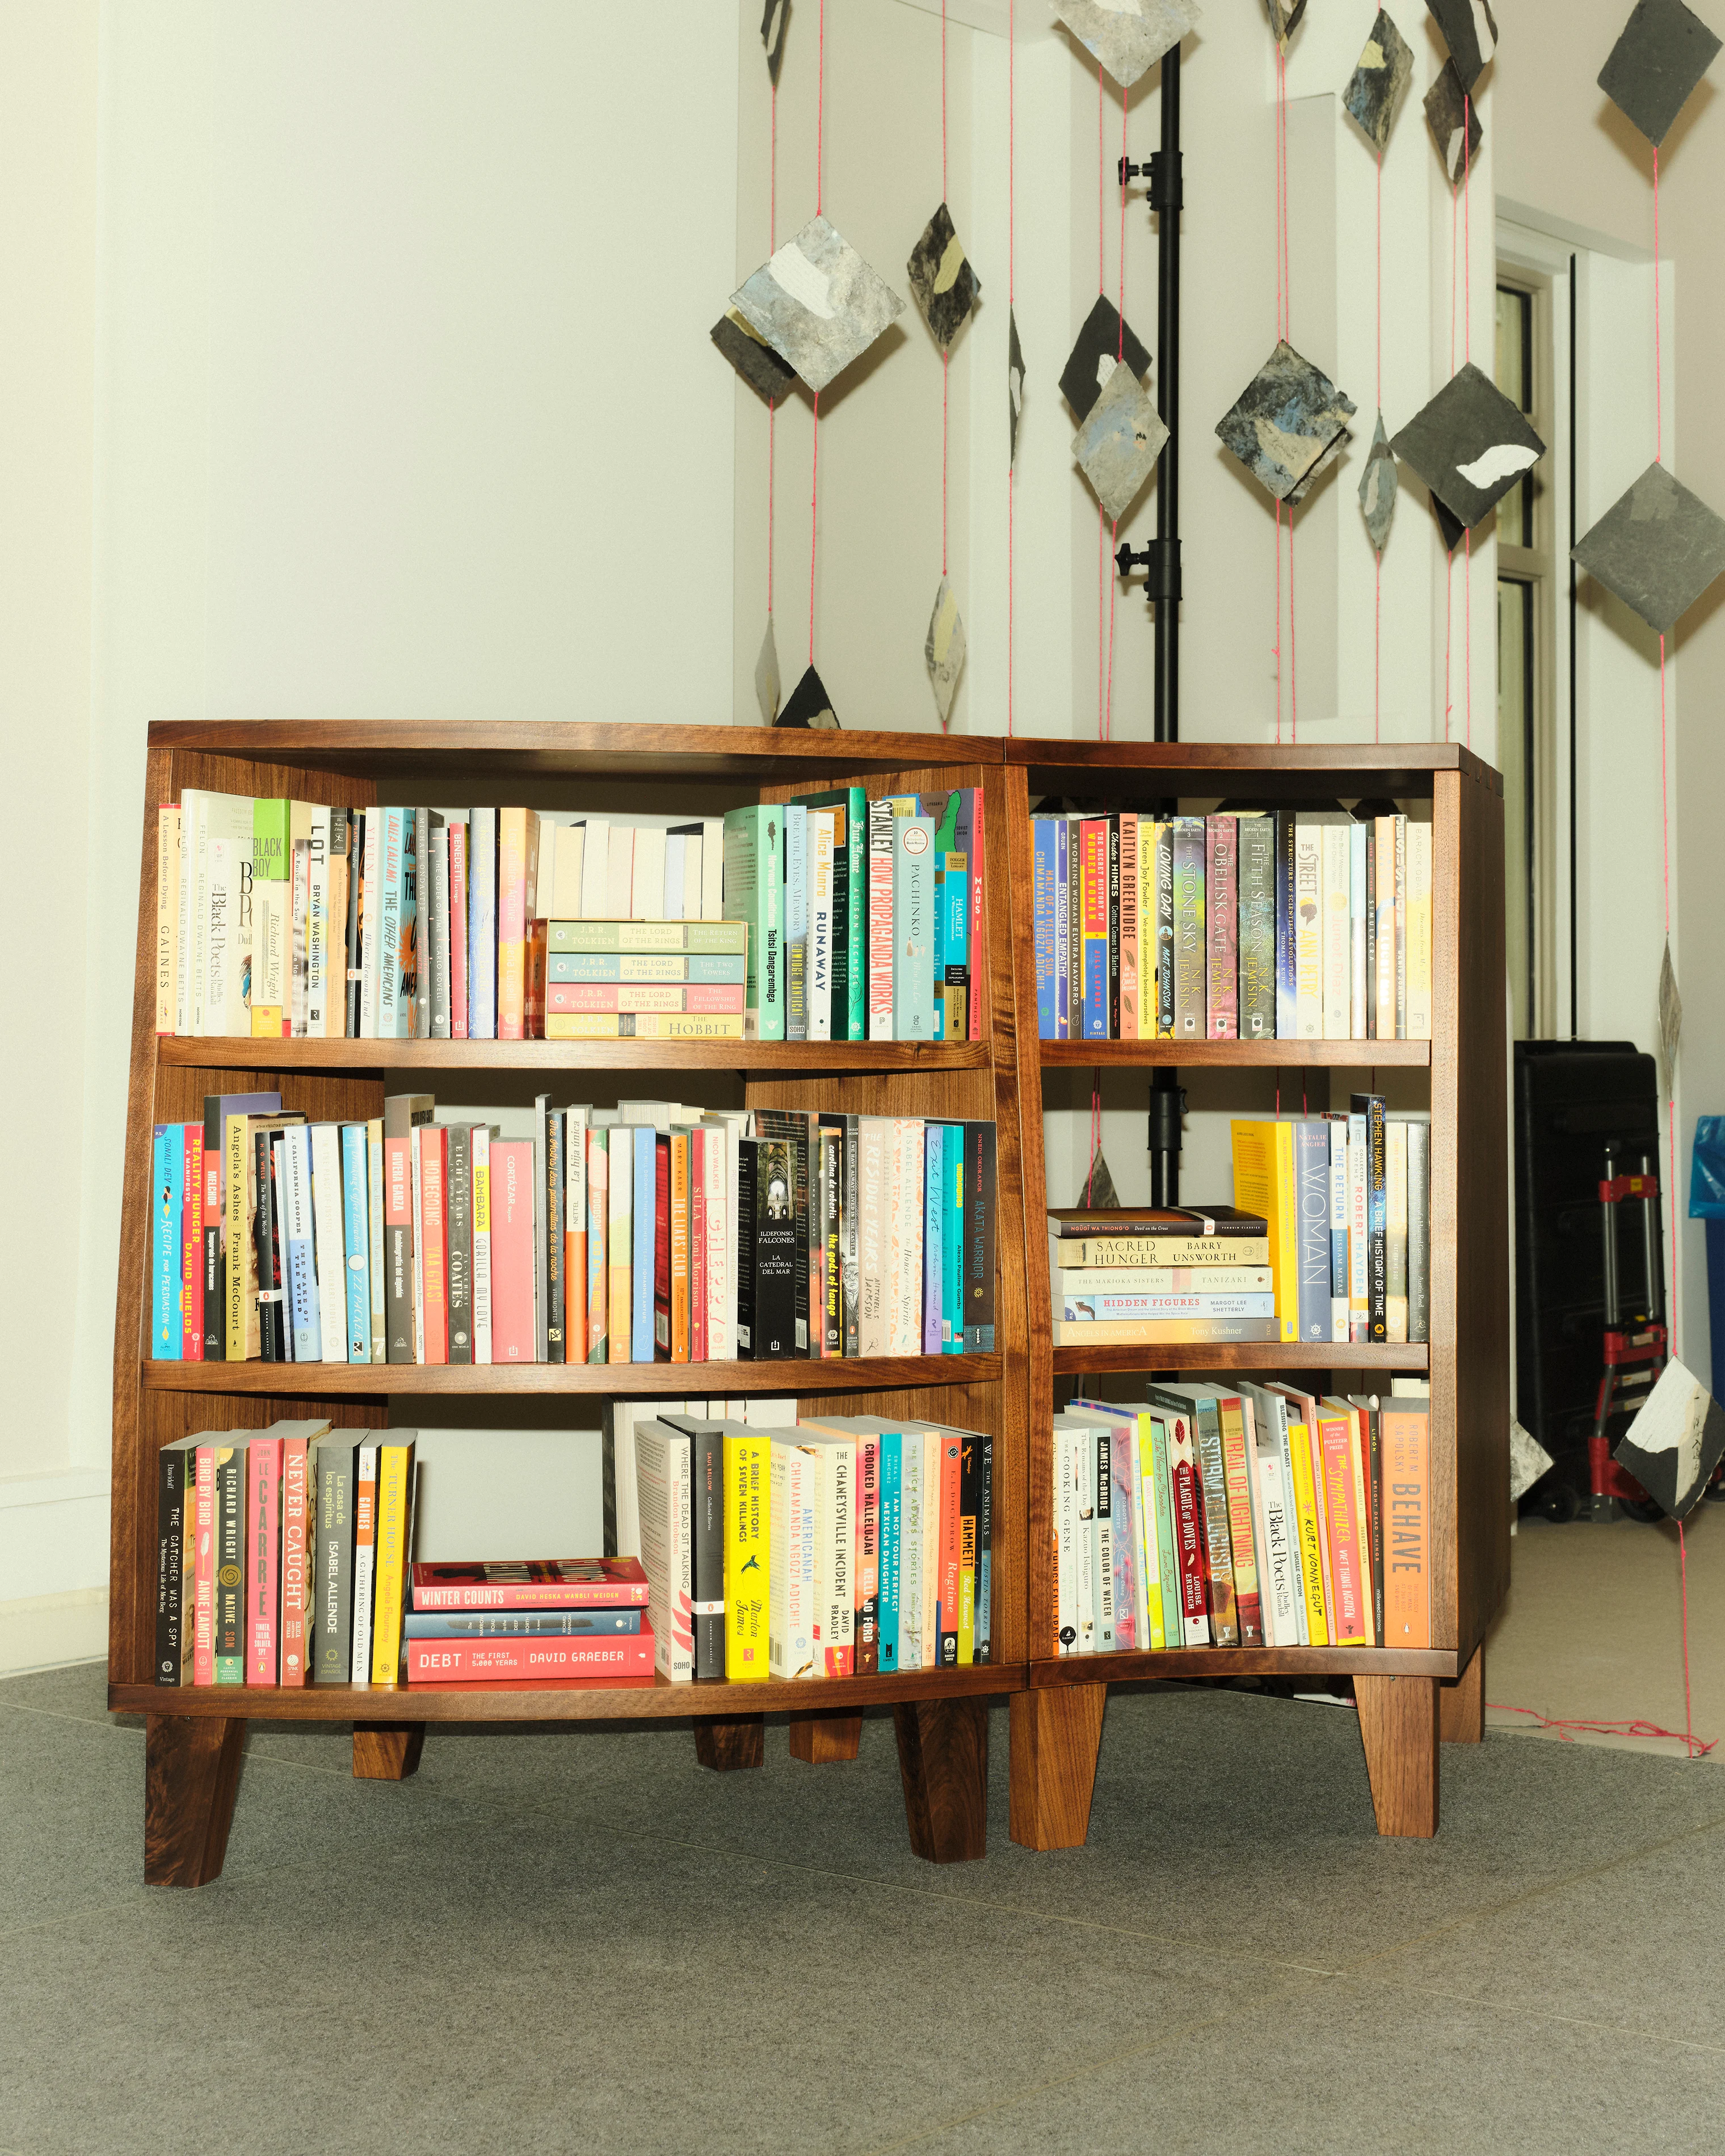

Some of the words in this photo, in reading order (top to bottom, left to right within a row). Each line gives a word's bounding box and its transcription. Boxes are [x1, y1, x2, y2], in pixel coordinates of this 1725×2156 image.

[312, 826, 323, 865] LOT
[388, 815, 400, 843] LAILA
[818, 829, 831, 856] Alice
[1111, 832, 1120, 861] Chester
[1122, 822, 1135, 869] KAITLYN
[254, 838, 281, 856] BLACK
[385, 845, 399, 883] LALAMI
[454, 833, 462, 882] BENEDETTI
[1251, 844, 1265, 885] FIFTH
[253, 859, 270, 877] BOY
[817, 862, 832, 897] Munro
[1140, 866, 1149, 881] Joy
[1160, 844, 1171, 890] LOVING
[385, 891, 398, 911] THE
[1122, 875, 1135, 939] GREENIDGE
[1160, 893, 1172, 920] DAY
[271, 913, 279, 958] Richard
[385, 917, 397, 950] OTHER
[975, 920, 979, 930] I
[1251, 891, 1265, 951] SEASON
[311, 919, 320, 988] WASHINGTON
[768, 929, 776, 949] Tsitsi
[816, 912, 826, 991] RUNAWAY
[161, 926, 169, 988] GAINES
[792, 944, 803, 977] EDWIDGE
[270, 962, 278, 999] Wright
[382, 951, 395, 1007] AMERICANS
[768, 951, 777, 1003] Dangarembga
[792, 981, 803, 1016] DANTICAT
[669, 1023, 730, 1034] HOBBIT
[571, 1121, 580, 1146] única
[1374, 1103, 1382, 1145] STEPHEN
[392, 1152, 403, 1182] RIVERA
[571, 1149, 580, 1172] hija
[1374, 1148, 1383, 1190] HAWKING
[208, 1171, 217, 1206] MELCHOR
[424, 1160, 440, 1226] HOMEGOING
[507, 1155, 516, 1205] CORTÁZAR
[1335, 1173, 1344, 1220] RETURN
[393, 1185, 405, 1211] GARZA
[476, 1170, 487, 1228] BAMBARA
[161, 1217, 172, 1256] RECIPE
[1302, 1163, 1327, 1284] WOMAN
[828, 1234, 839, 1249] the
[1095, 1254, 1158, 1264] HUNGER
[1097, 1241, 1155, 1252] SACRED
[451, 1251, 462, 1308] COATES
[828, 1251, 839, 1274] gods
[161, 1274, 171, 1325] PERSUASION
[828, 1287, 839, 1317] tango
[1190, 1327, 1209, 1336] Tony
[199, 1458, 212, 1483] BIRD
[1100, 1442, 1109, 1472] JAMES
[199, 1485, 211, 1498] BY
[288, 1455, 303, 1517] NEVER
[1100, 1475, 1109, 1510] McBRIDE
[198, 1500, 212, 1526] BIRD
[359, 1497, 370, 1529] GAINES
[1269, 1509, 1283, 1549] Black
[1392, 1483, 1421, 1573] BEHAVE
[963, 1519, 974, 1568] HAMMETT
[1304, 1519, 1316, 1548] KURT
[287, 1526, 302, 1609] CAUGHT
[329, 1542, 338, 1580] ISABEL
[1272, 1551, 1285, 1590] Poets
[197, 1580, 211, 1607] ANNE
[422, 1591, 460, 1605] WINTER
[465, 1590, 503, 1604] COUNTS
[945, 1563, 958, 1613] Ragtime
[1307, 1553, 1323, 1616] VONNEGUT
[328, 1582, 338, 1633] ALLENDE
[197, 1610, 211, 1649] LAMOTT
[420, 1654, 461, 1667] DEBT
[530, 1653, 566, 1663] DAVID
[572, 1652, 624, 1662] GRAEBER
